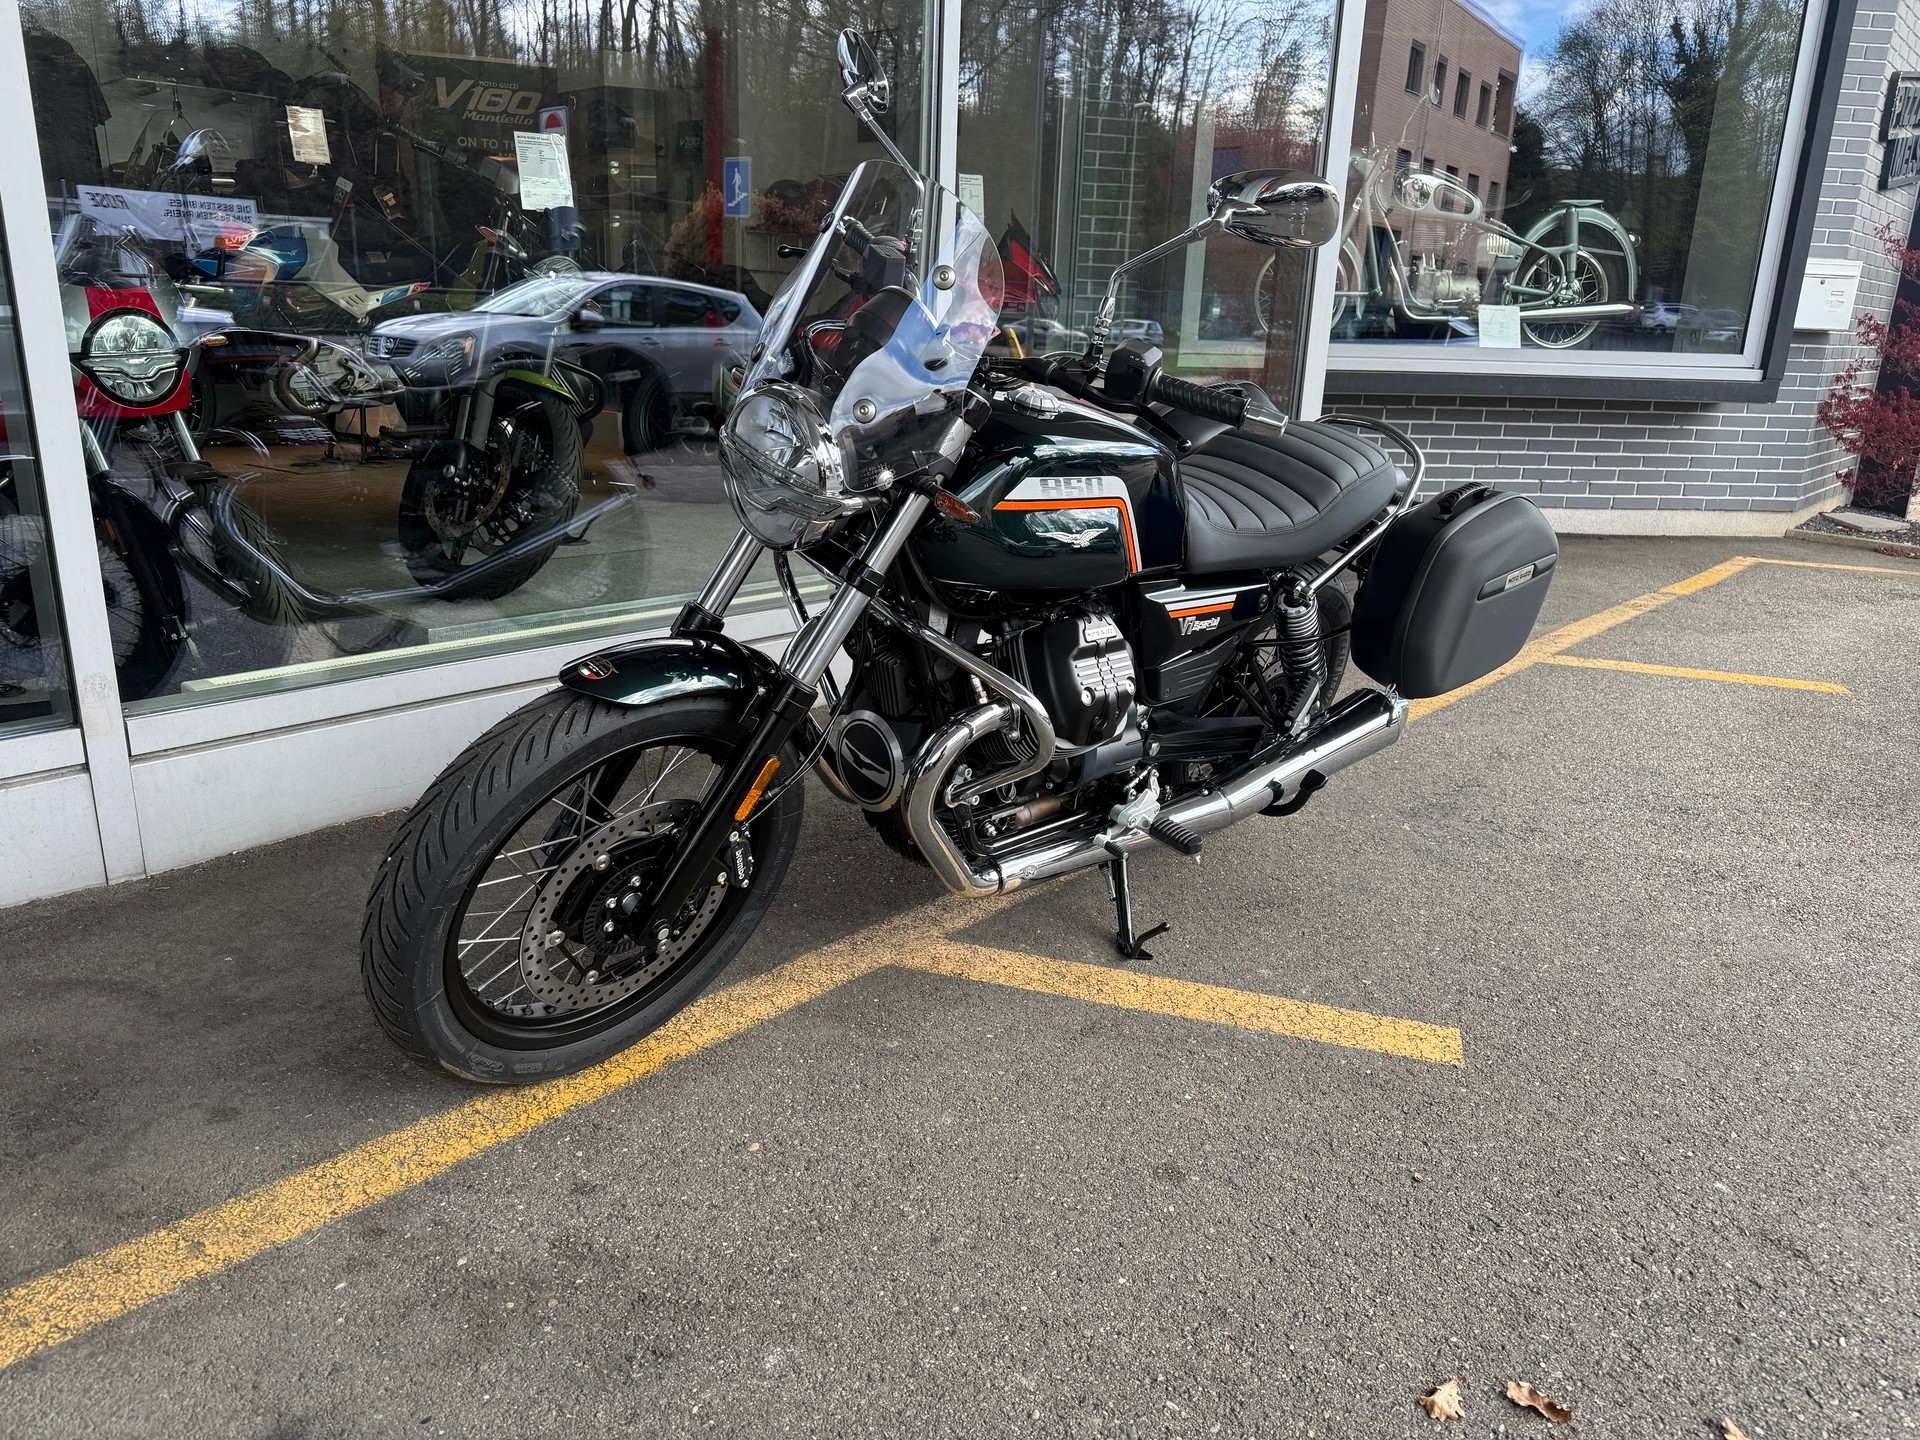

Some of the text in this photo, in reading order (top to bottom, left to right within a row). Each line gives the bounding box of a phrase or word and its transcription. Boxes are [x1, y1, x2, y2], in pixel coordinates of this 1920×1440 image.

[479, 80, 519, 90] MOTO GUZZI
[436, 76, 542, 116] V100
[1891, 86, 1920, 128] PIZZ
[462, 110, 534, 126] Mandello
[457, 136, 477, 148] ON
[481, 138, 499, 149] TO
[503, 139, 516, 151] TH
[1039, 476, 1104, 497] 850
[1178, 616, 1197, 636] V7
[735, 847, 746, 880] brembo
